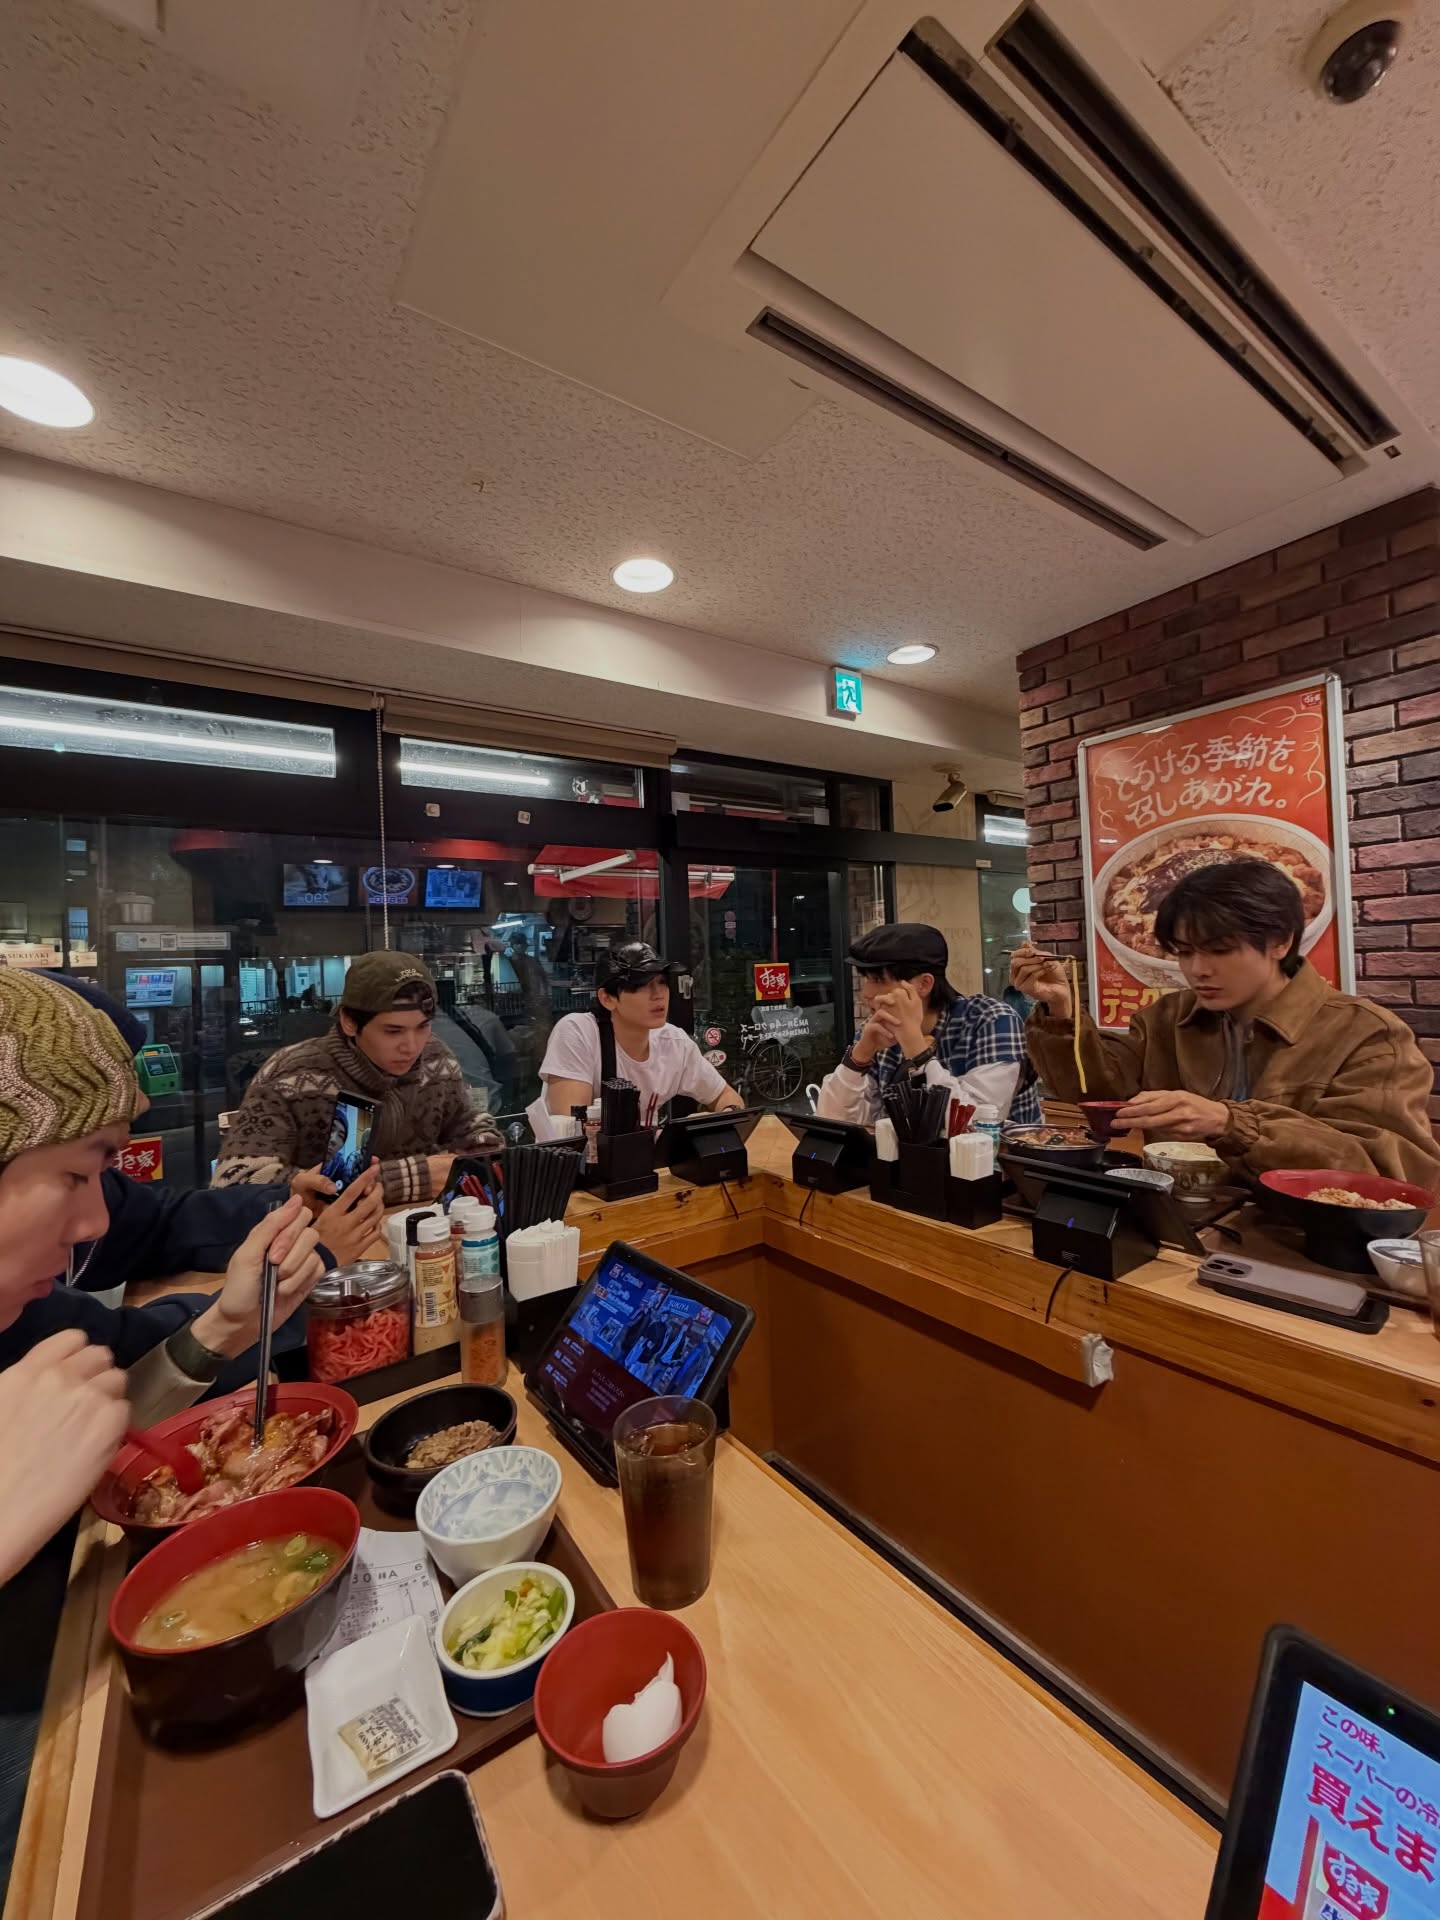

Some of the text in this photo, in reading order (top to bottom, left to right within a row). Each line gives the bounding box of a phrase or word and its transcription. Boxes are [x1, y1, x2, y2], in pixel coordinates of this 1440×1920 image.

[1115, 732, 1296, 800] とろける季節を、
[1125, 774, 1288, 829] 召しあがれ。
[759, 967, 787, 990] すき家
[1321, 1704, 1387, 1760] この味、
[1316, 1733, 1440, 1829] スーパーの冷
[1306, 1761, 1438, 1884] 買えま
[1327, 1852, 1381, 1914] すき家
